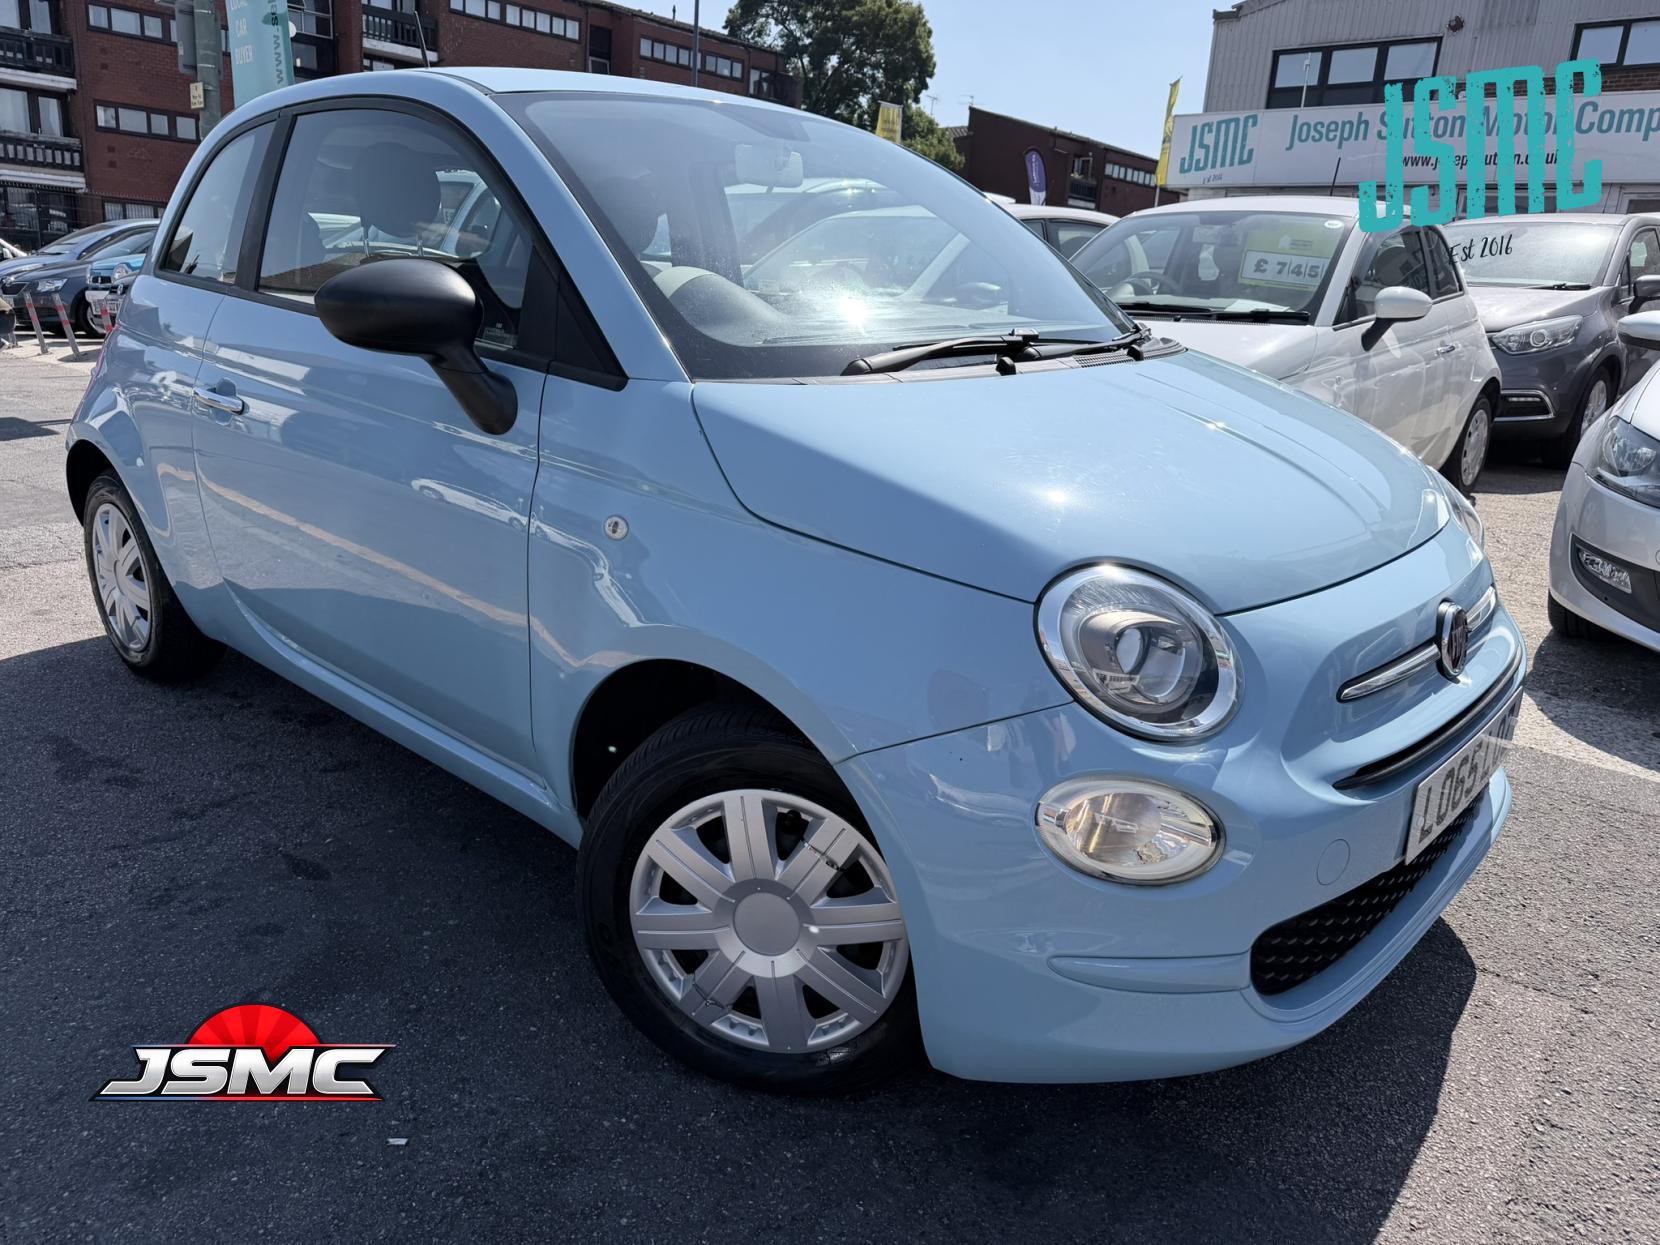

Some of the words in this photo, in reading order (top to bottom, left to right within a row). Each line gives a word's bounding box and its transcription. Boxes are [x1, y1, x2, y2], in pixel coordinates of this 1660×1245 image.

[1179, 114, 1258, 174] JSMC
[1285, 111, 1370, 151] Joseph
[1377, 108, 1466, 140] Son
[1575, 101, 1660, 142] Comp
